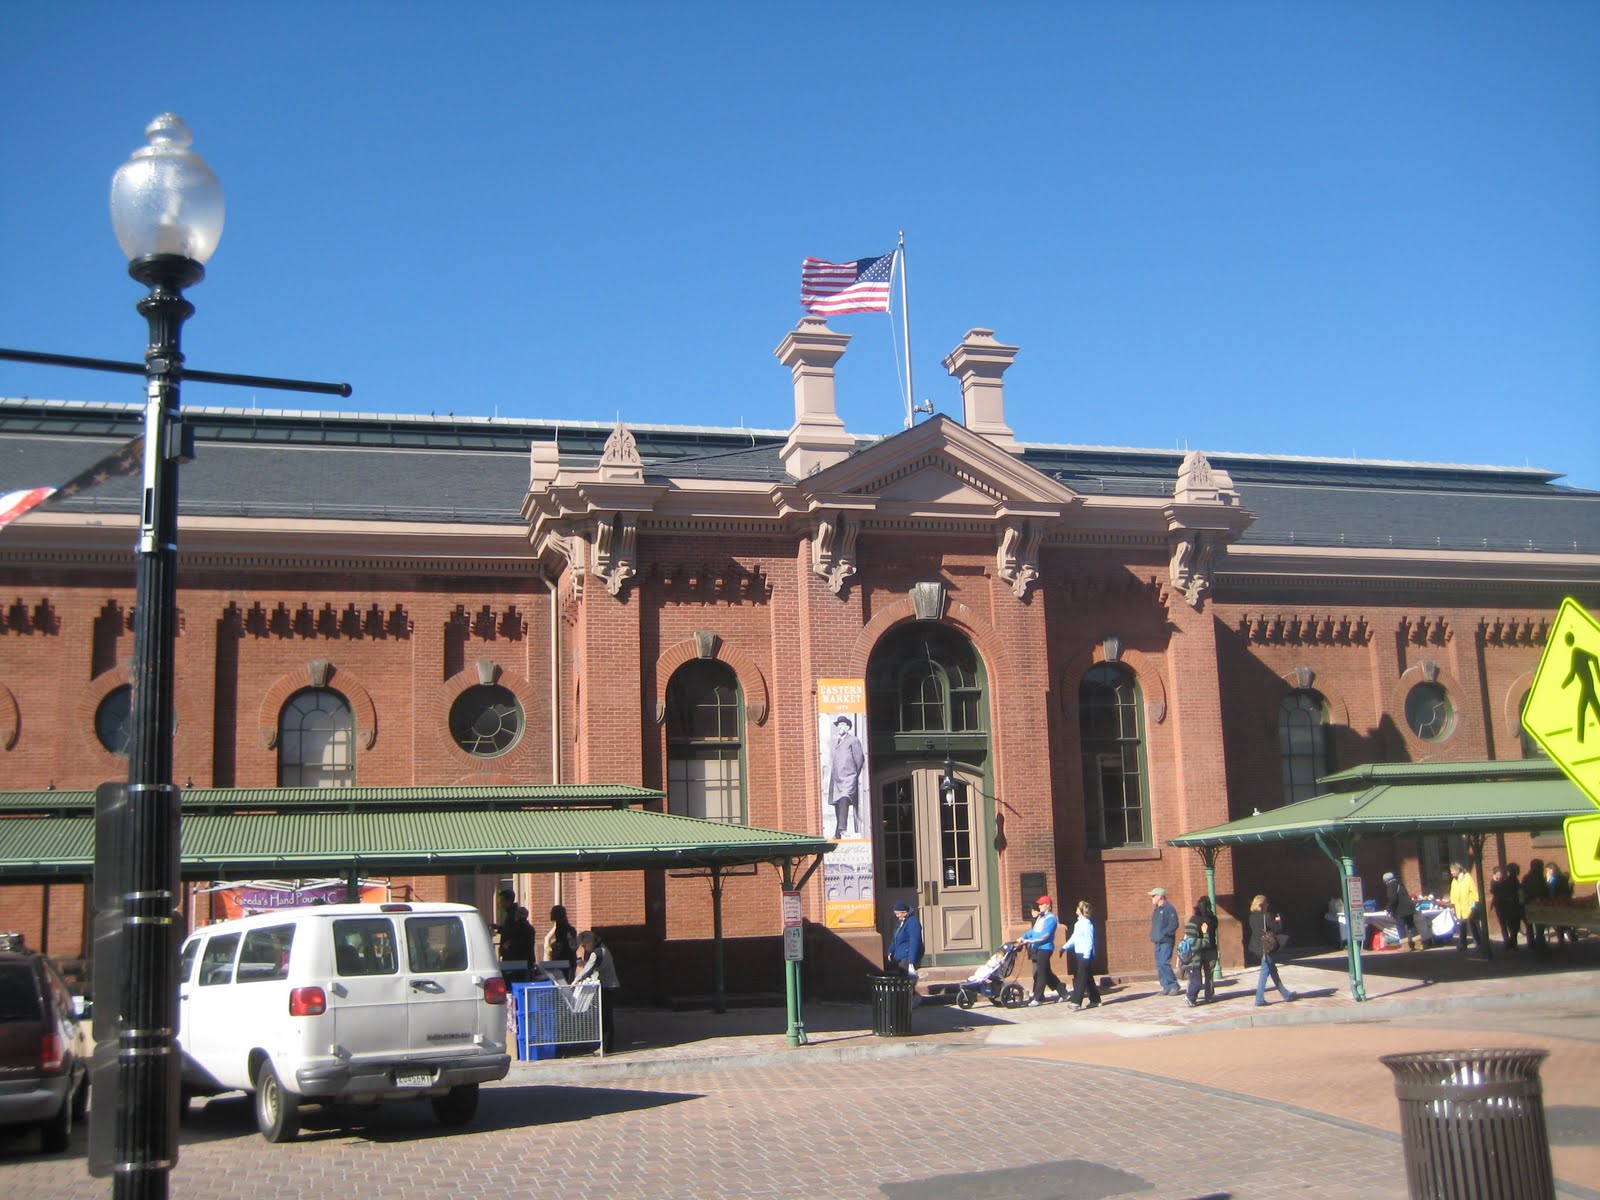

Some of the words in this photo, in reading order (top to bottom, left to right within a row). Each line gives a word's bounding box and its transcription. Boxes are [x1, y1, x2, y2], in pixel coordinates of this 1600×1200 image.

[820, 686, 862, 694] EASTERN
[823, 695, 862, 703] MARKET
[270, 894, 295, 906] Hand
[296, 892, 326, 904] Pourd
